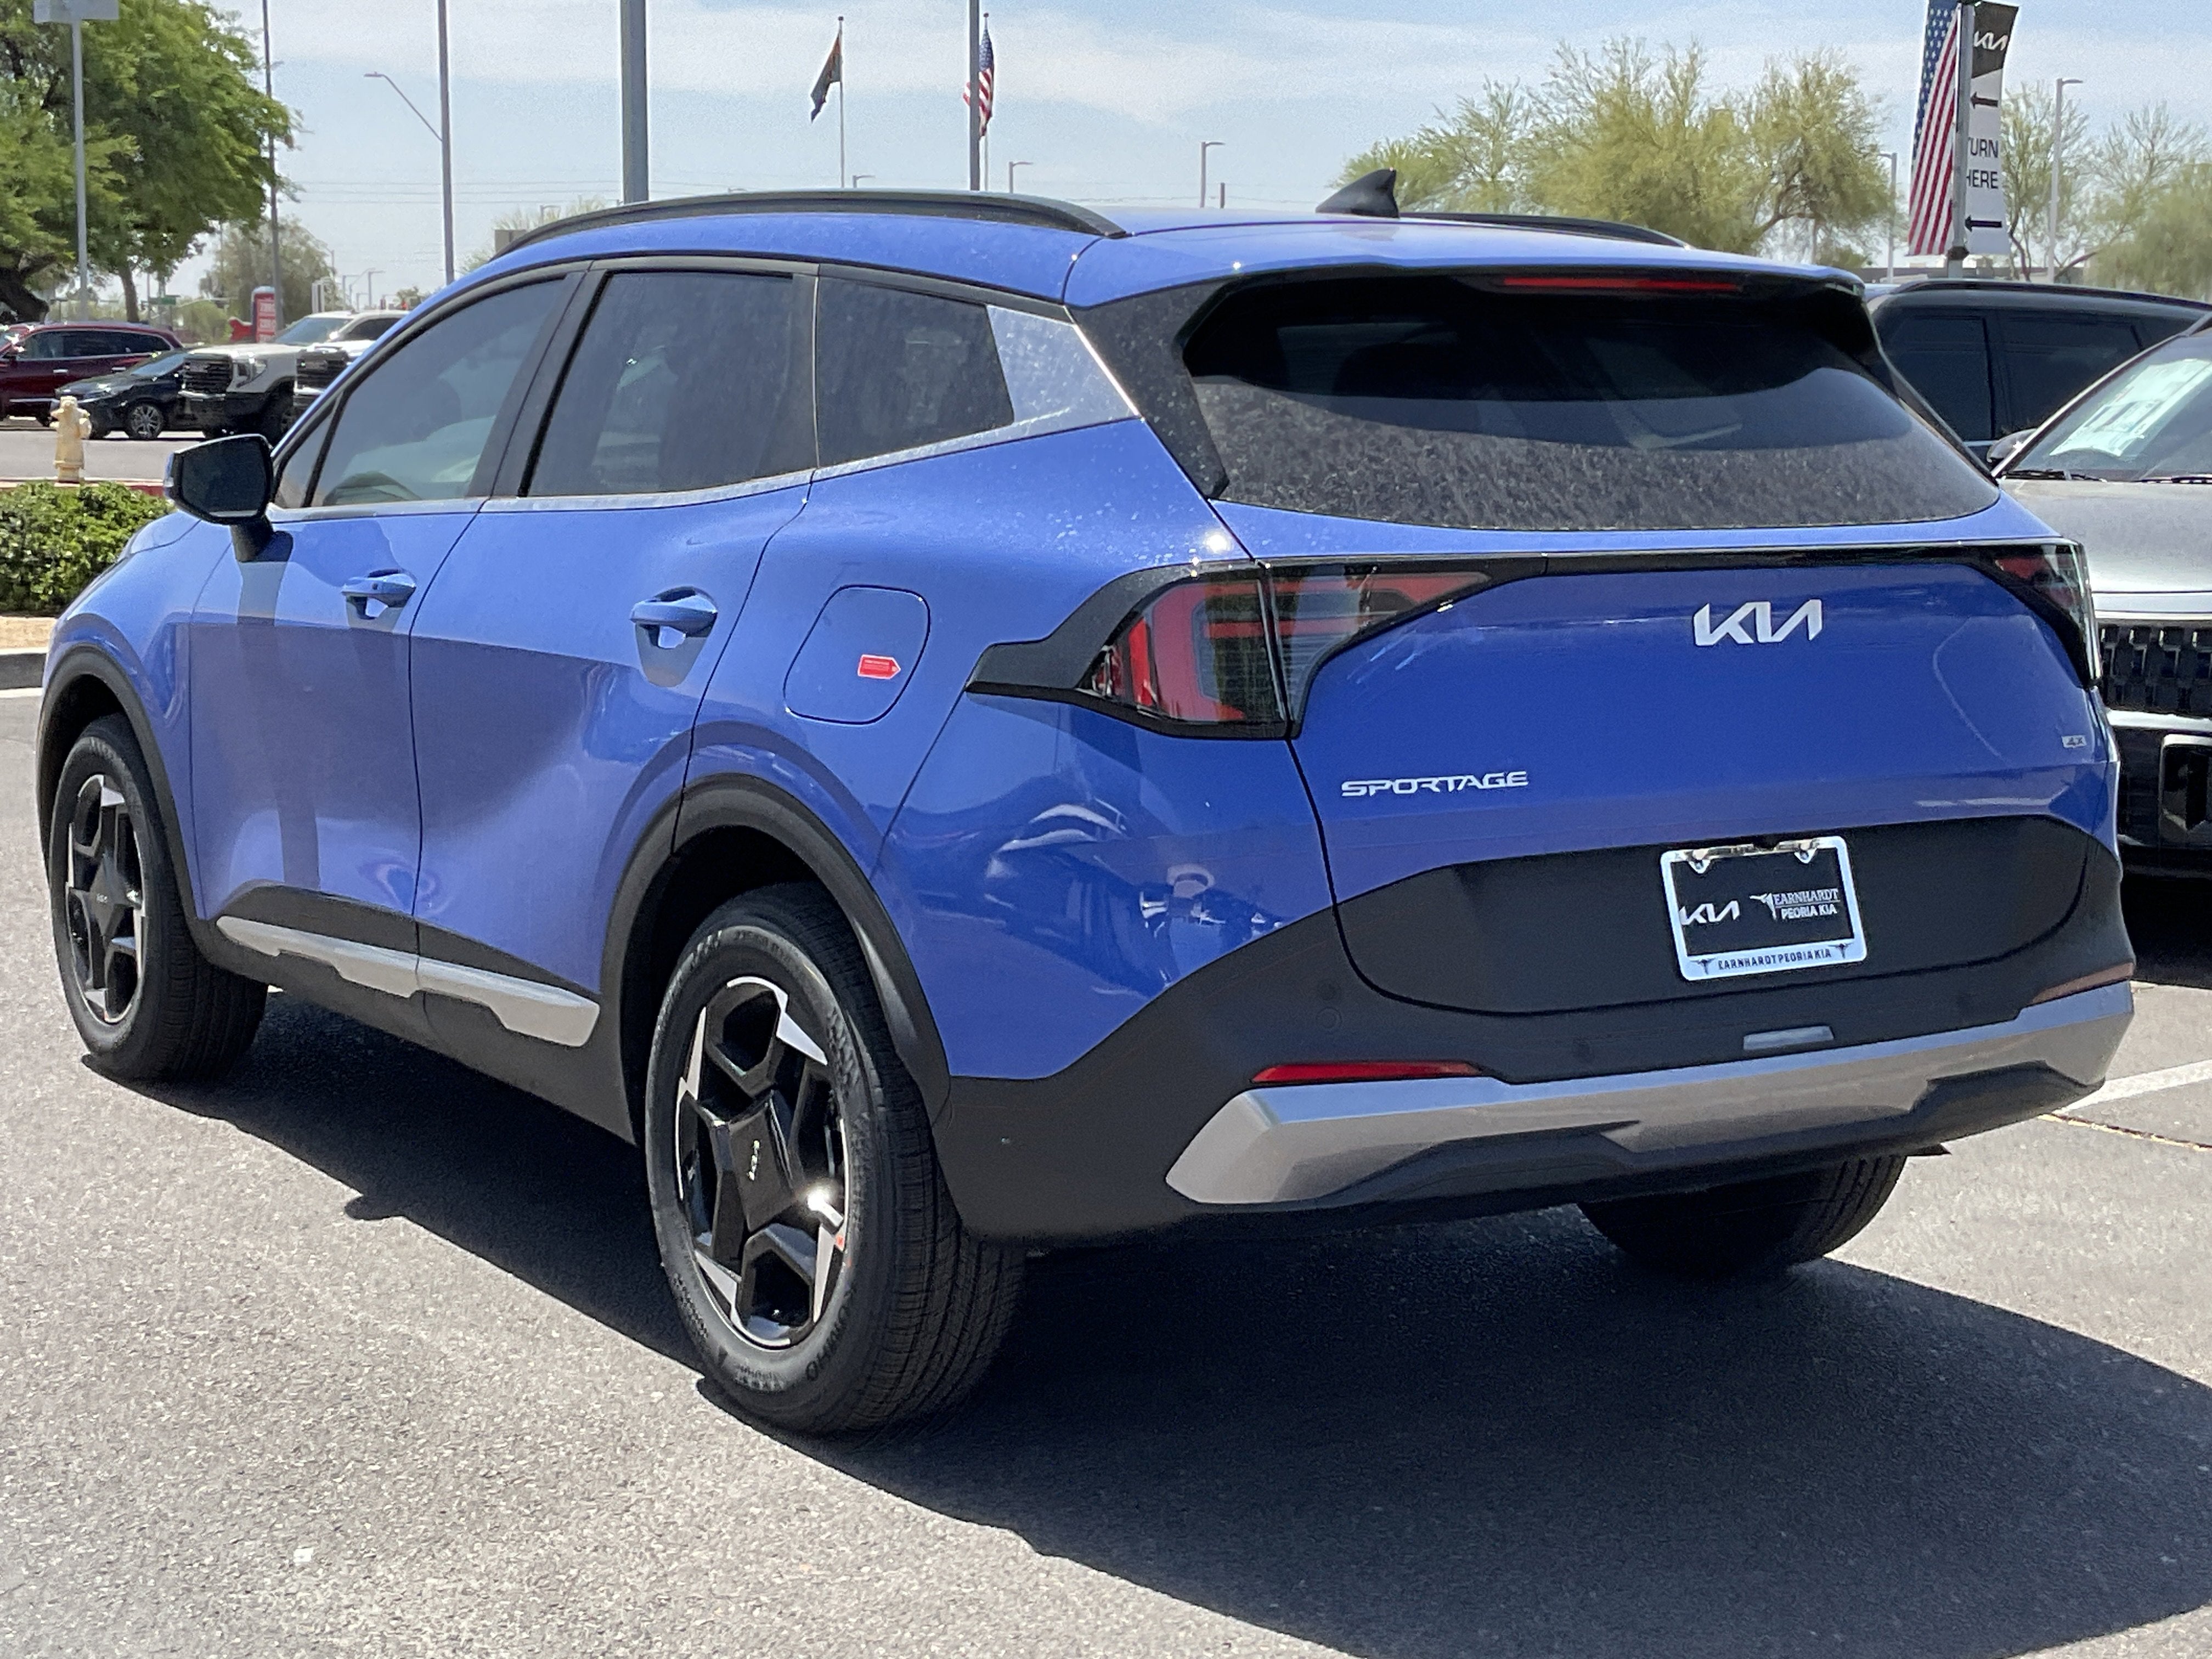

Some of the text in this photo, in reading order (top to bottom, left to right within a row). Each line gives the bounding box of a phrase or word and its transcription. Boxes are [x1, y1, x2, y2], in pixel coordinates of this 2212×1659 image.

[1974, 31, 2008, 50] KIA
[1693, 599, 1822, 646] KIA
[1341, 770, 1529, 797] SPORTAGE
[1773, 888, 1838, 906] EARNHARDT
[1679, 900, 1740, 926] KIA
[1781, 903, 1838, 919] PEORIA KIA
